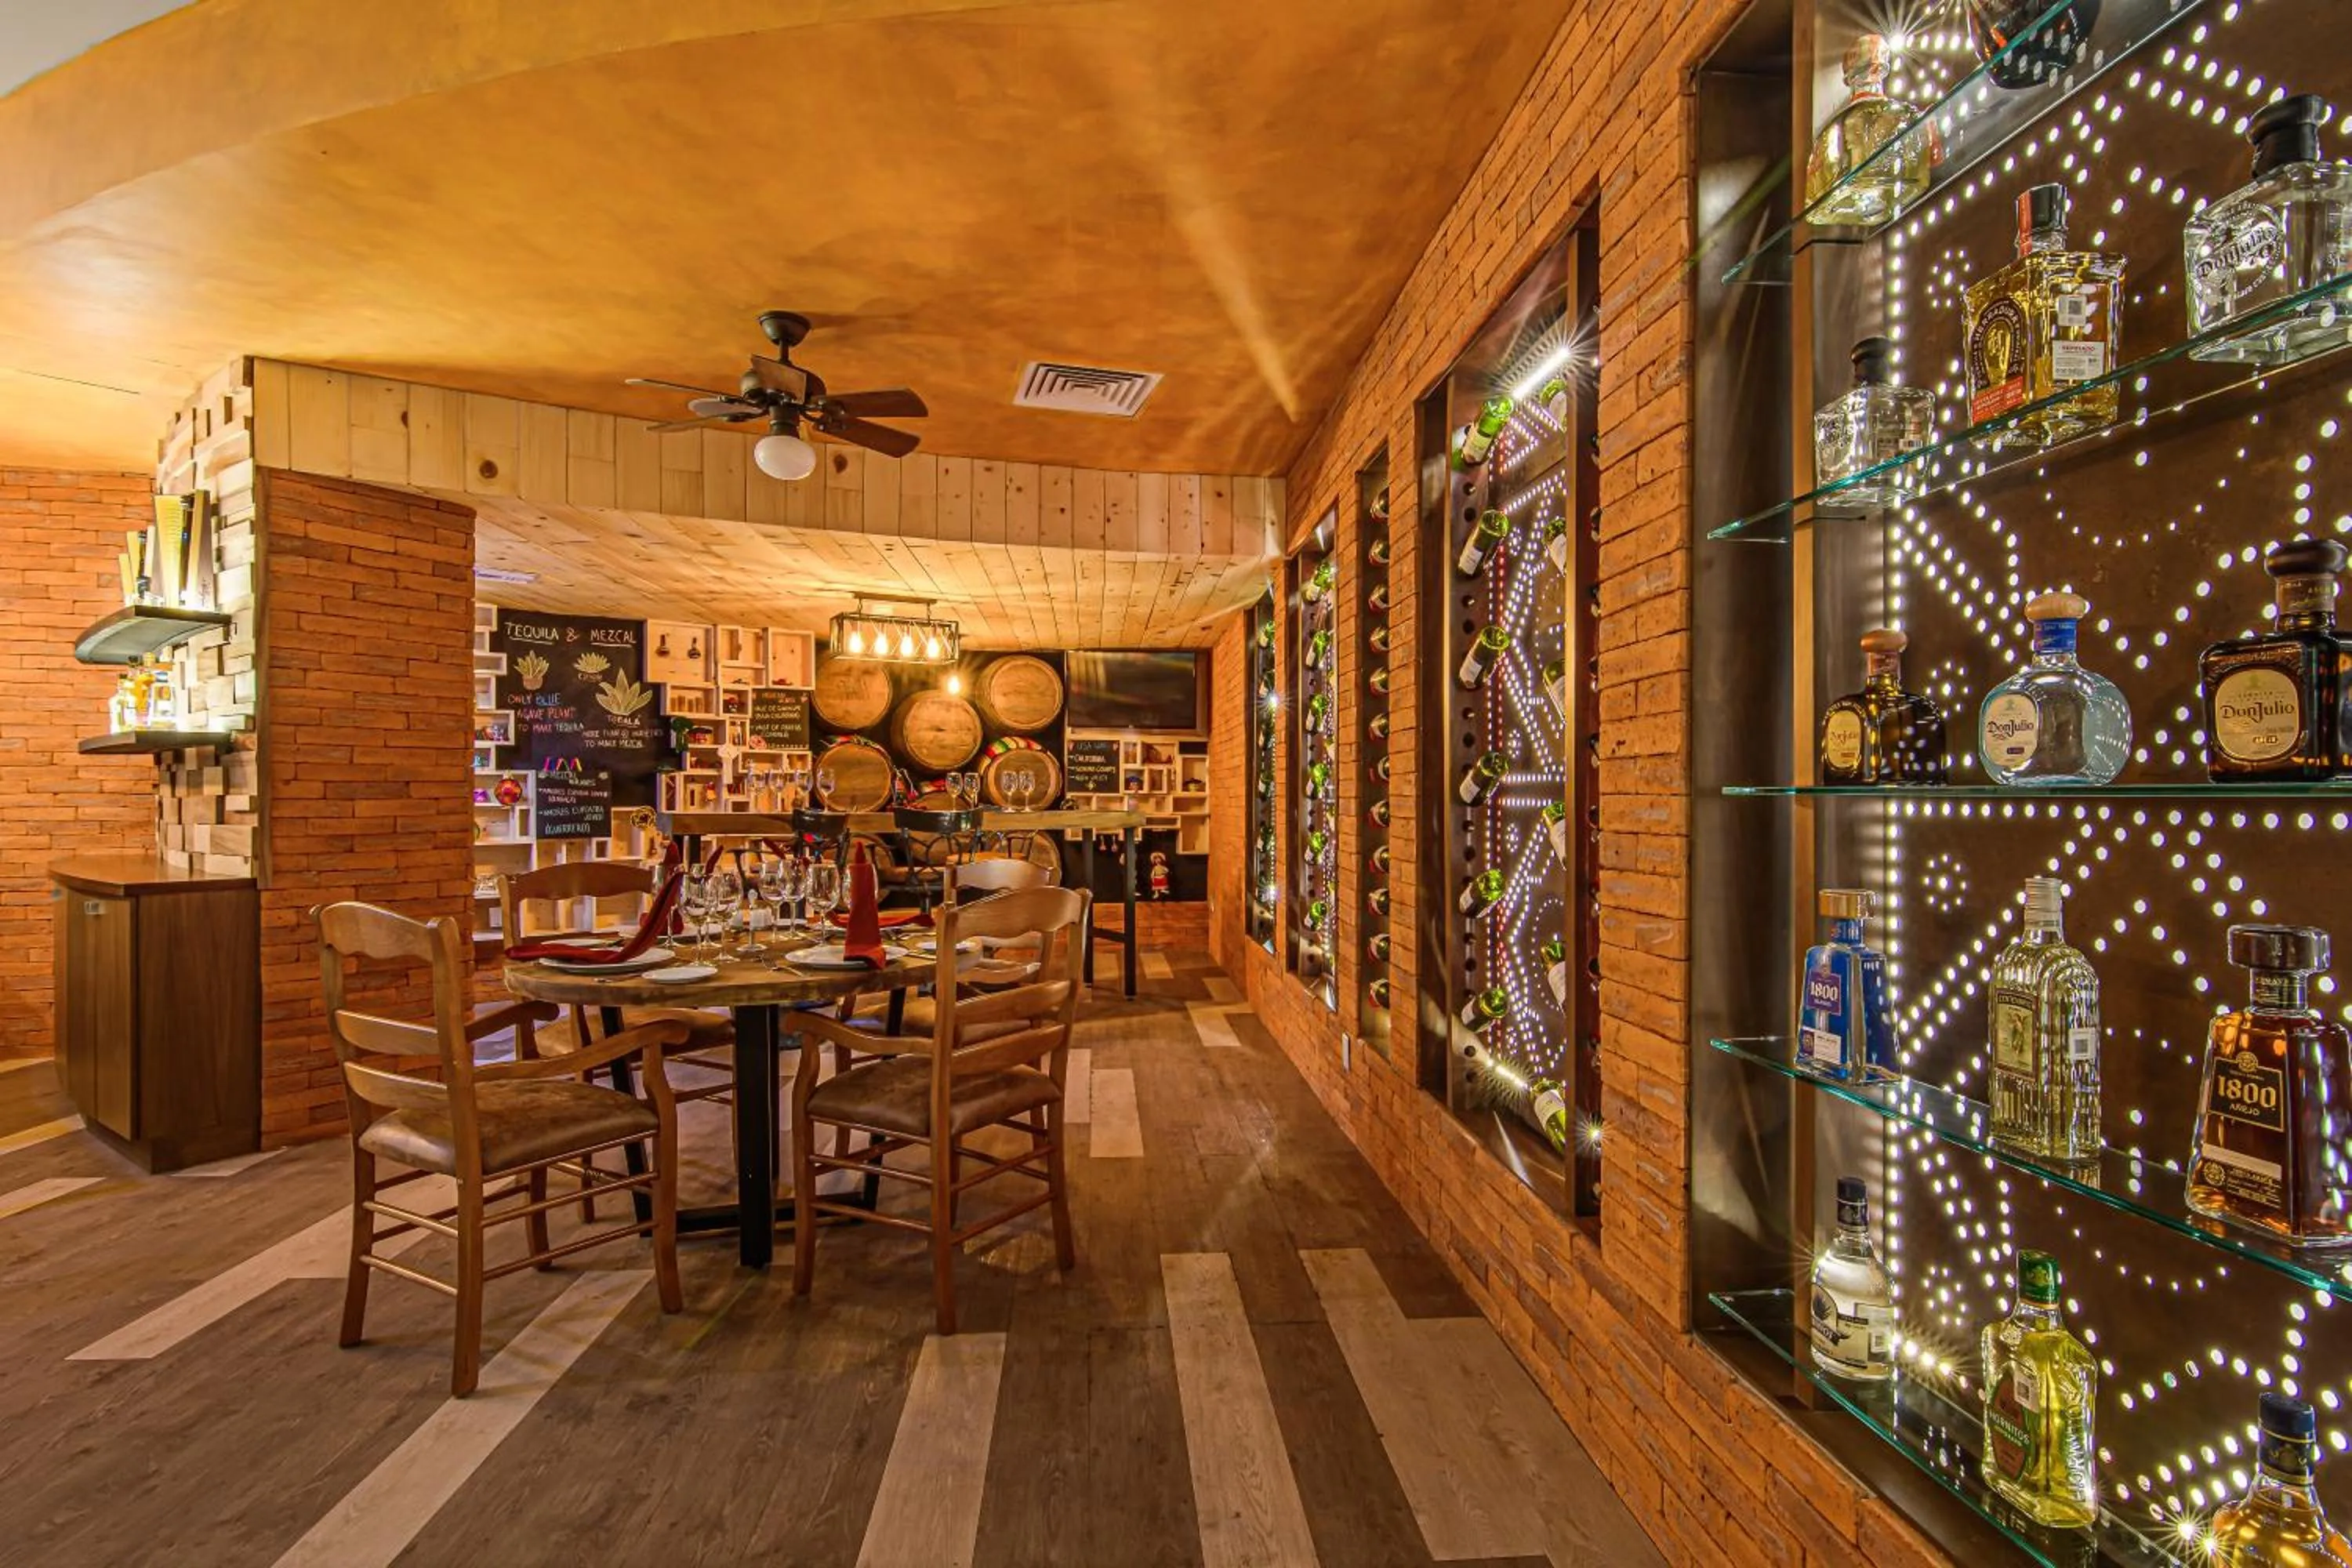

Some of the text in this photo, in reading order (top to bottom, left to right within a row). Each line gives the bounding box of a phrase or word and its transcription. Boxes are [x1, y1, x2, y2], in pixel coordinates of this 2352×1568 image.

[503, 622, 637, 644] TEQUILA & MEZCAL
[507, 692, 561, 705] ONLY BLUE
[517, 706, 576, 720] AGAVE PLANT
[517, 724, 528, 732] TO
[533, 724, 553, 733] MAKE
[584, 739, 595, 748] TO
[1809, 981, 1838, 1002] 1800
[2217, 1075, 2277, 1108] 1800
[1988, 1410, 2031, 1446] HORNITOS
